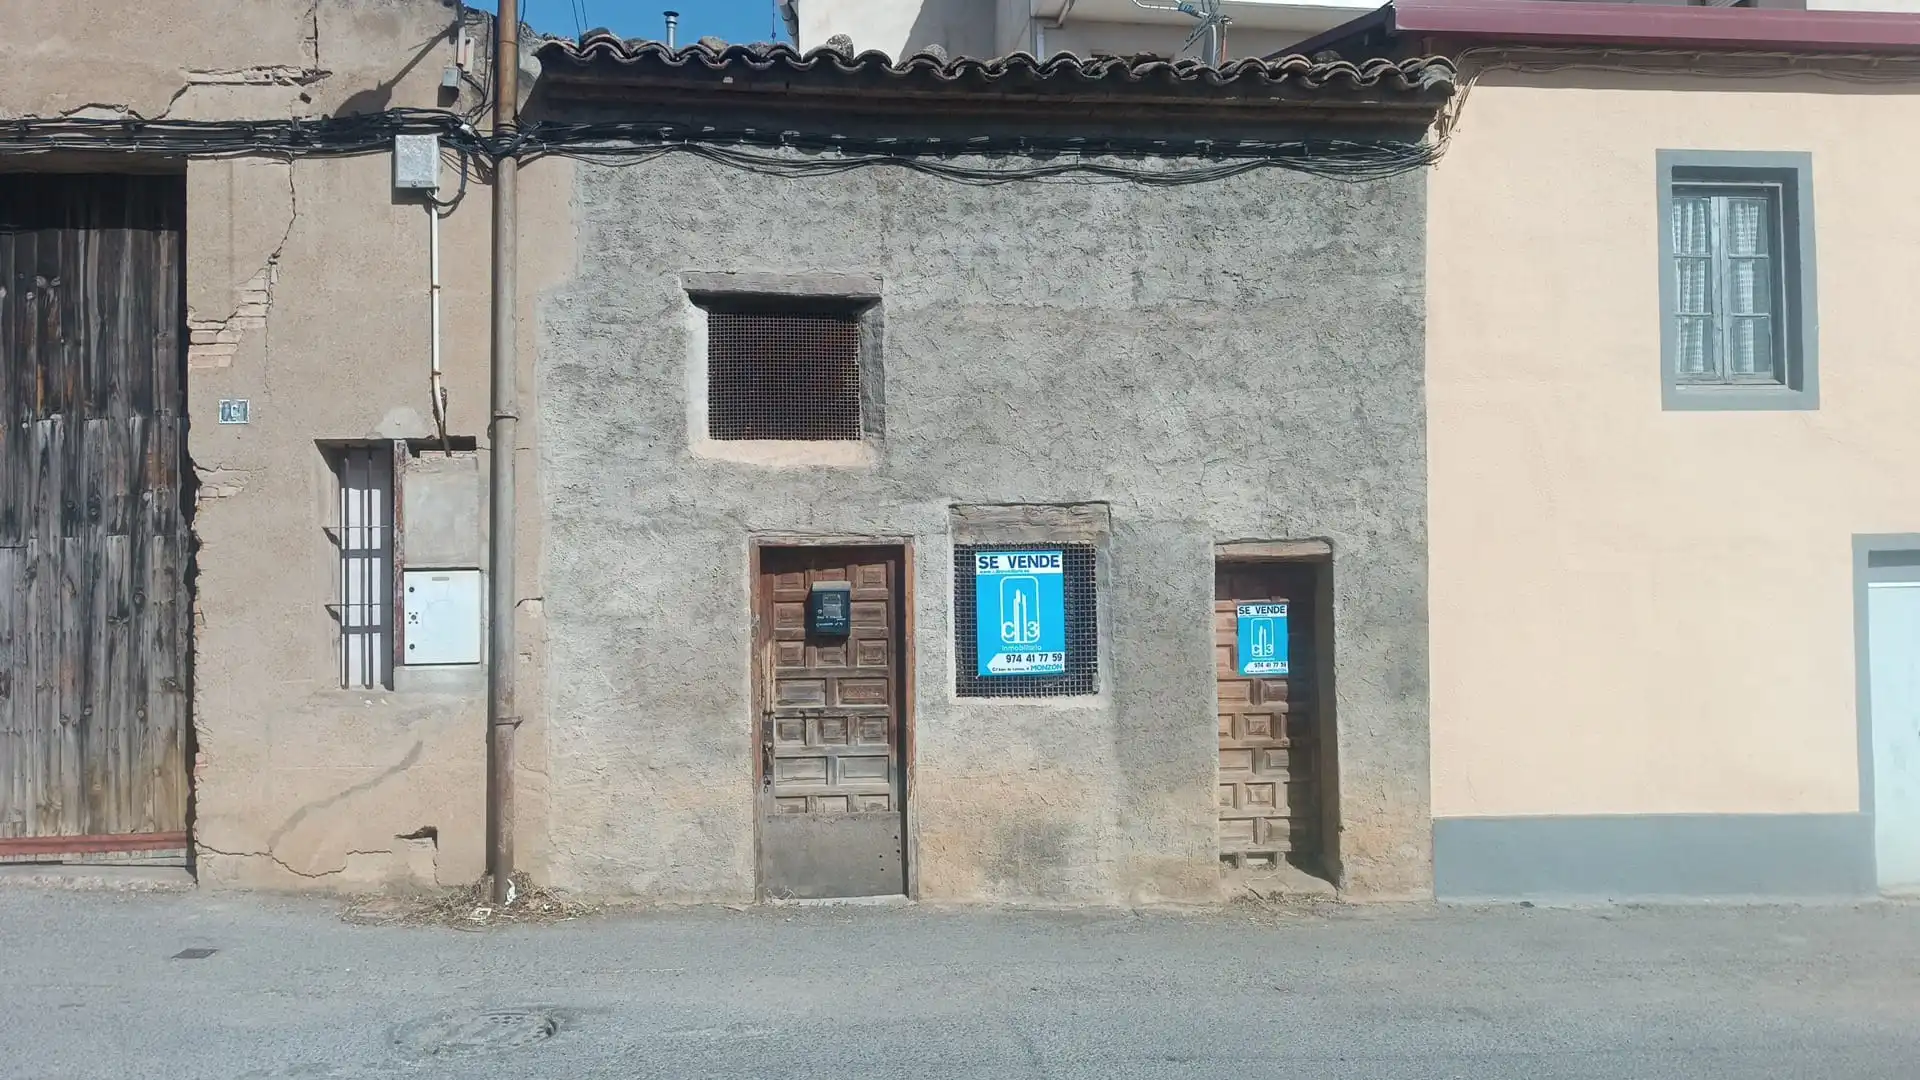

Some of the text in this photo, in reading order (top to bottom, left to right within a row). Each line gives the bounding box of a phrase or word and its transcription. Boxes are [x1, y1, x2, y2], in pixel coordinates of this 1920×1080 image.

[978, 554, 1060, 569] SE VENDE
[1238, 605, 1286, 615] SE VENDE
[1005, 653, 1063, 663] 974 41 77 59
